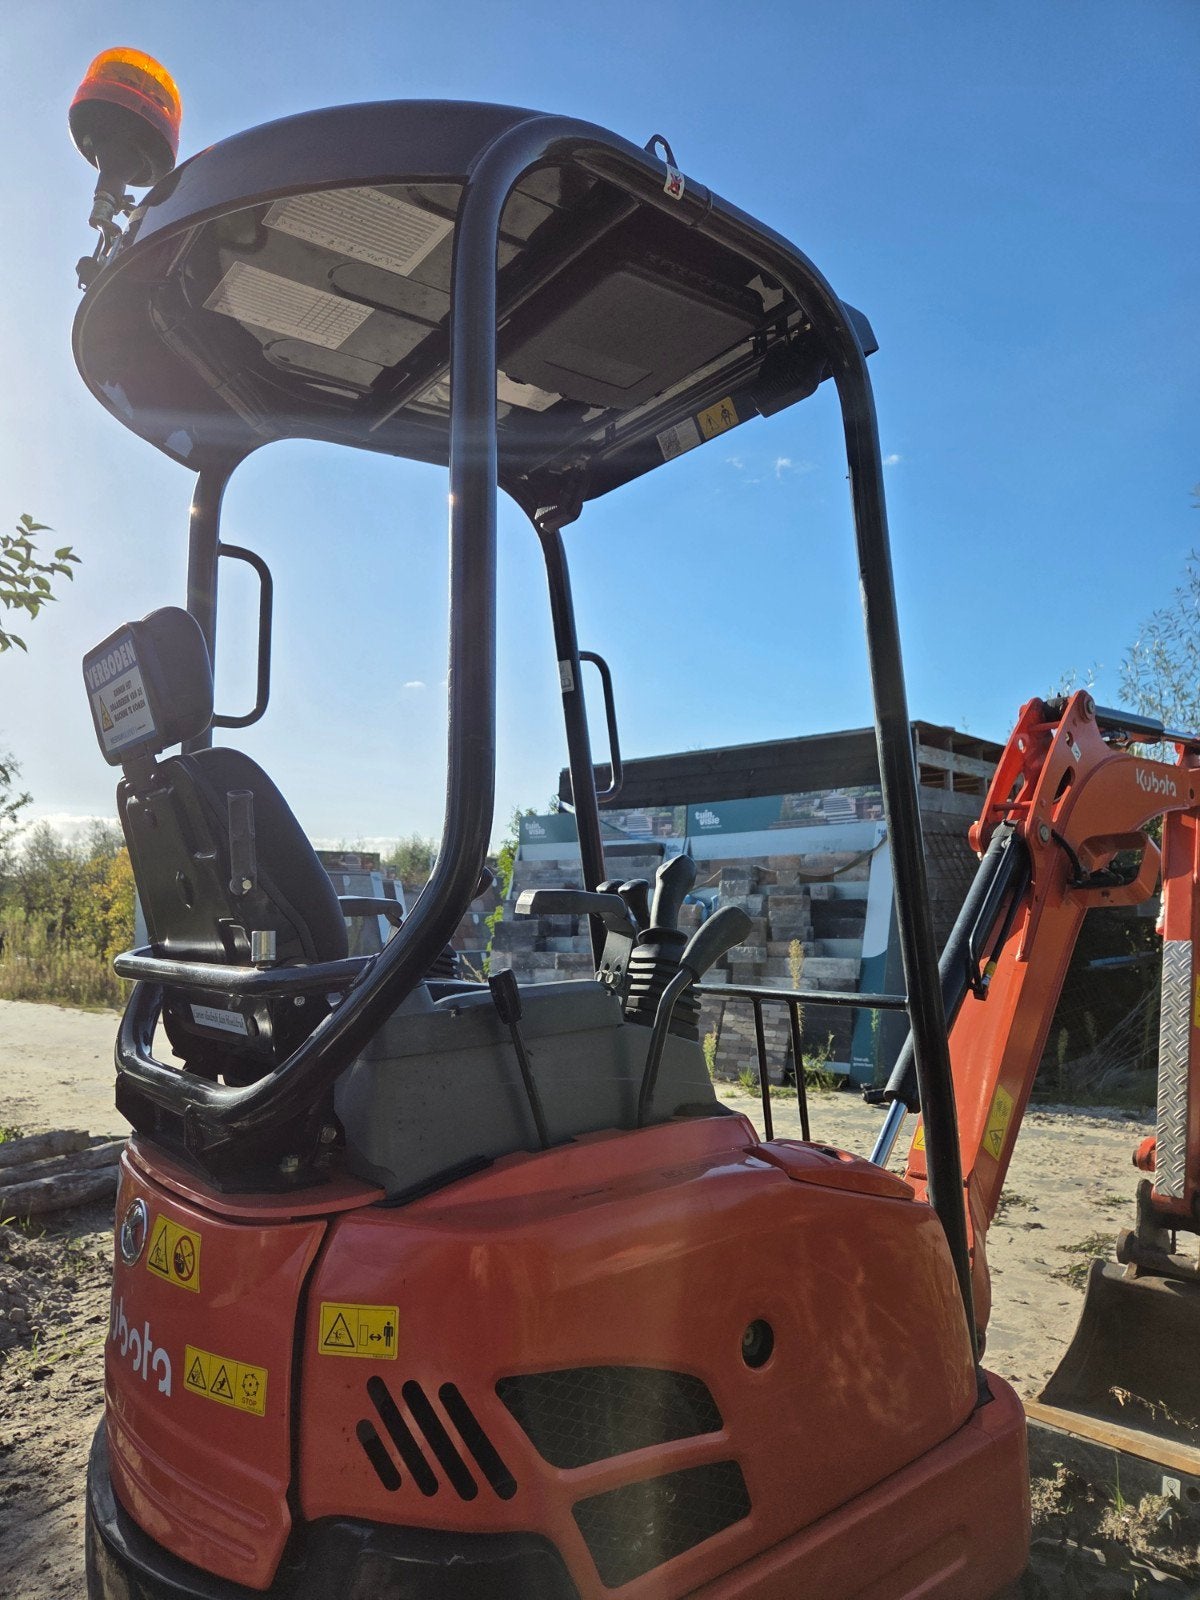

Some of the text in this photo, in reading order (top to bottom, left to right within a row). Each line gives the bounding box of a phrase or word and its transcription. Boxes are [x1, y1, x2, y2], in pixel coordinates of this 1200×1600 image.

[86, 640, 137, 690] VERBODEN
[1136, 768, 1177, 797] Kubota
[112, 1296, 172, 1398] ubota
[241, 1396, 257, 1406] STOP
